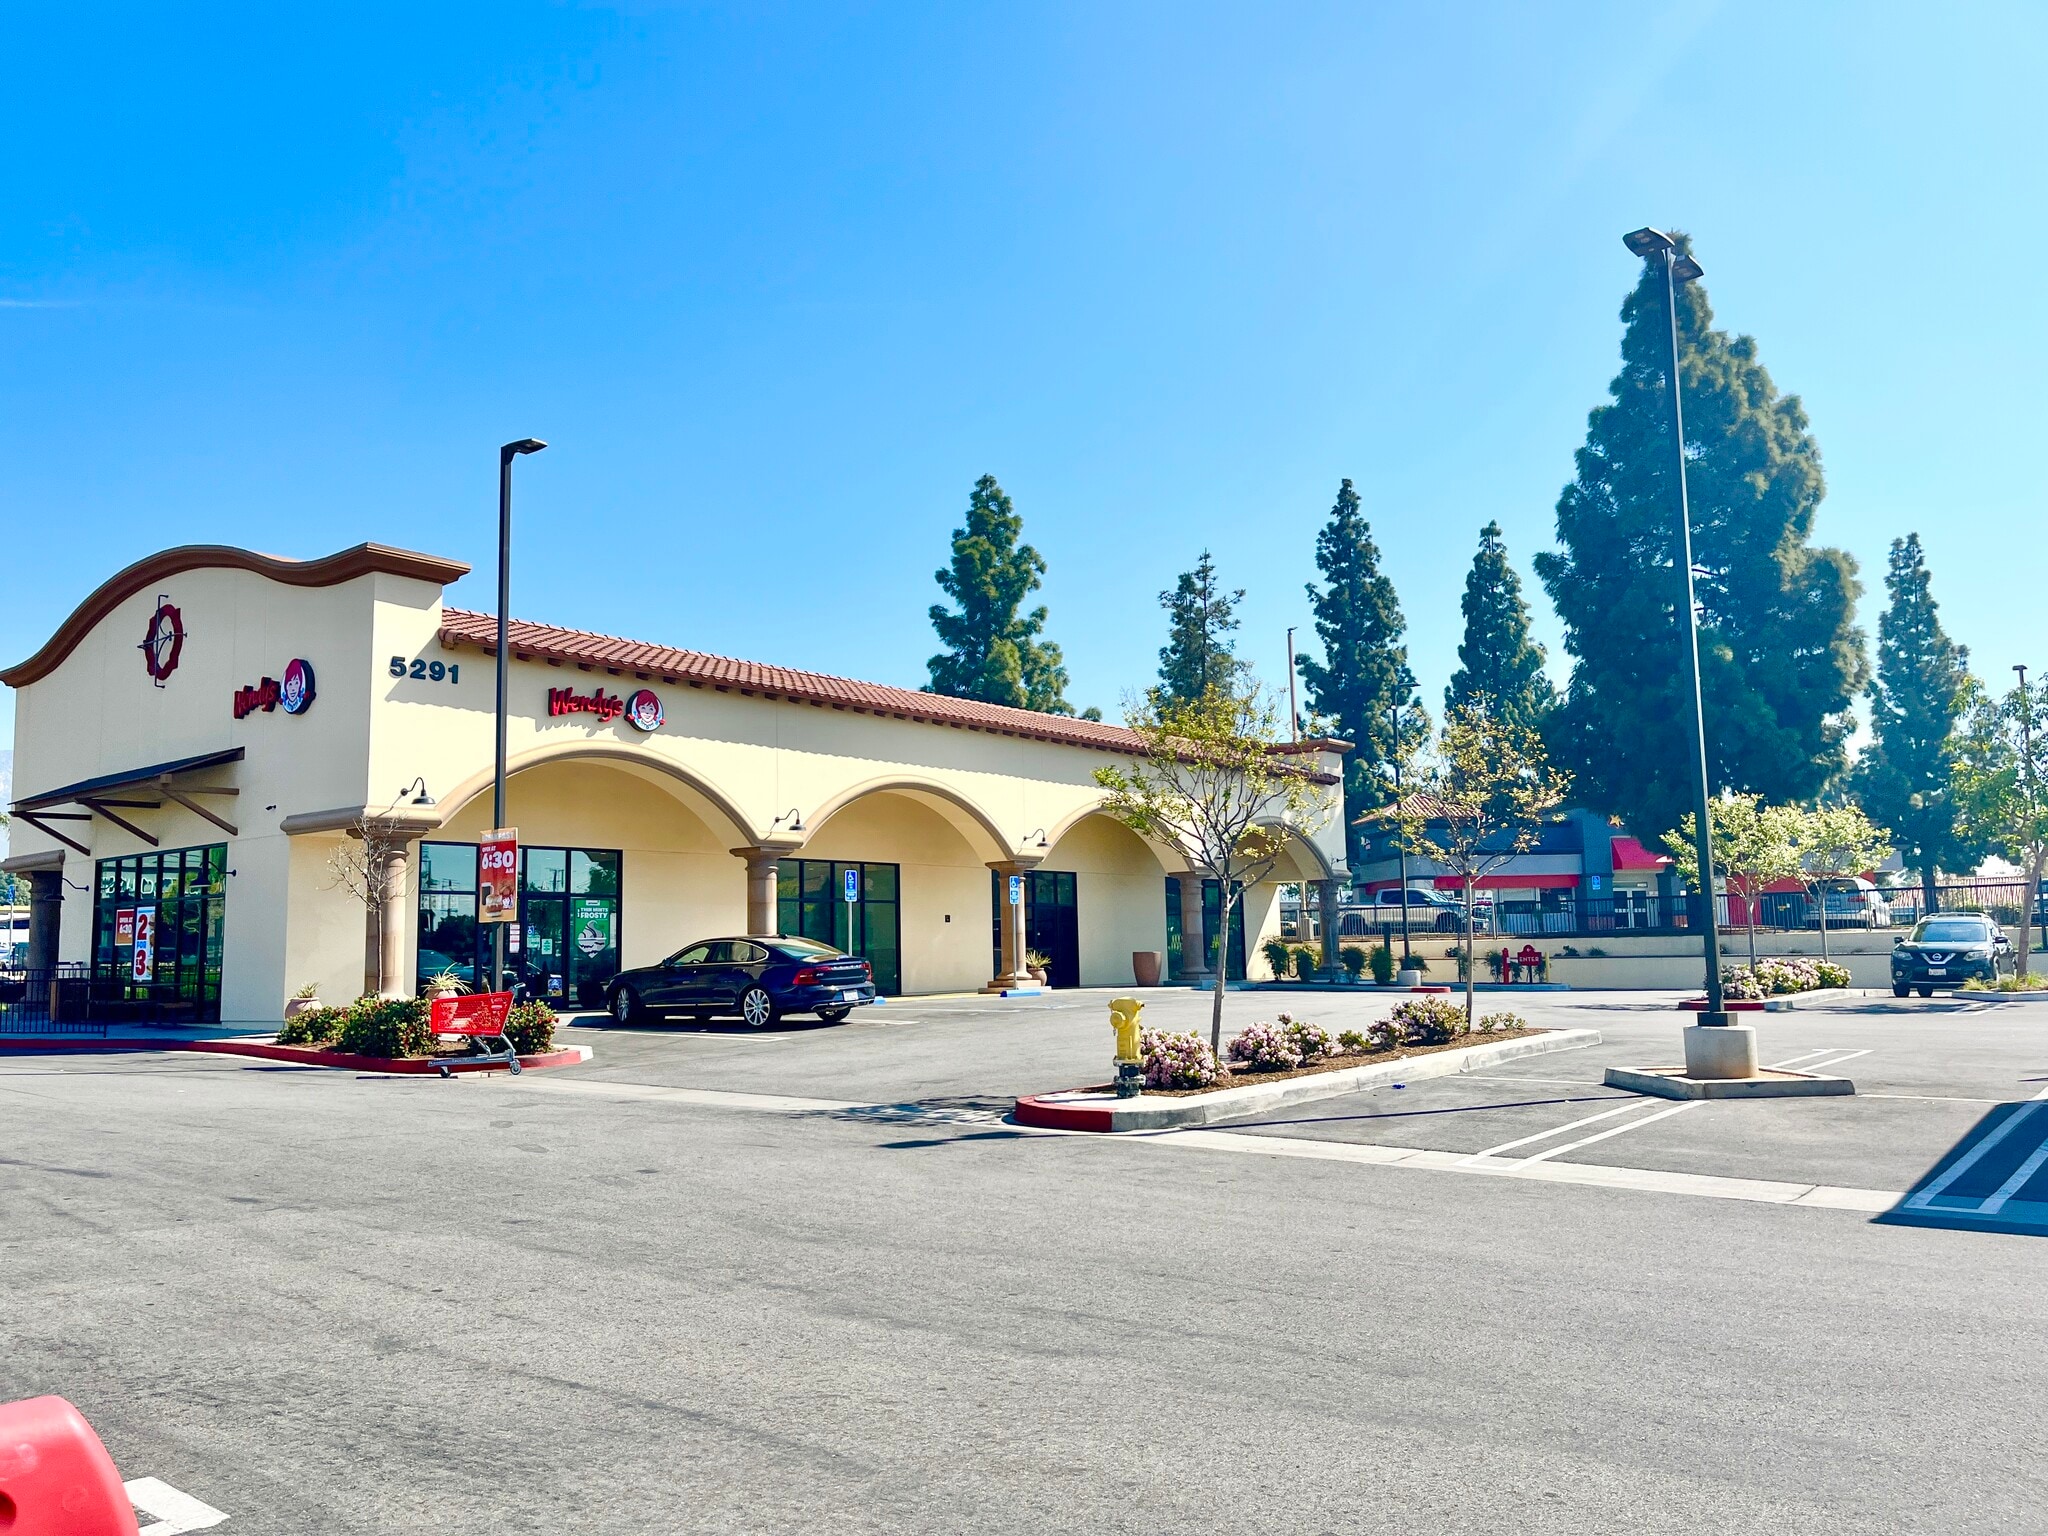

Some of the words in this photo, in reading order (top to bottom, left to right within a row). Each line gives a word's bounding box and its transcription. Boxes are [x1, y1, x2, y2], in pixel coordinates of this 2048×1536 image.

[389, 655, 459, 684] 5291
[548, 686, 623, 722] Wendy's
[482, 850, 514, 870] 6:30
[138, 914, 148, 940] 2
